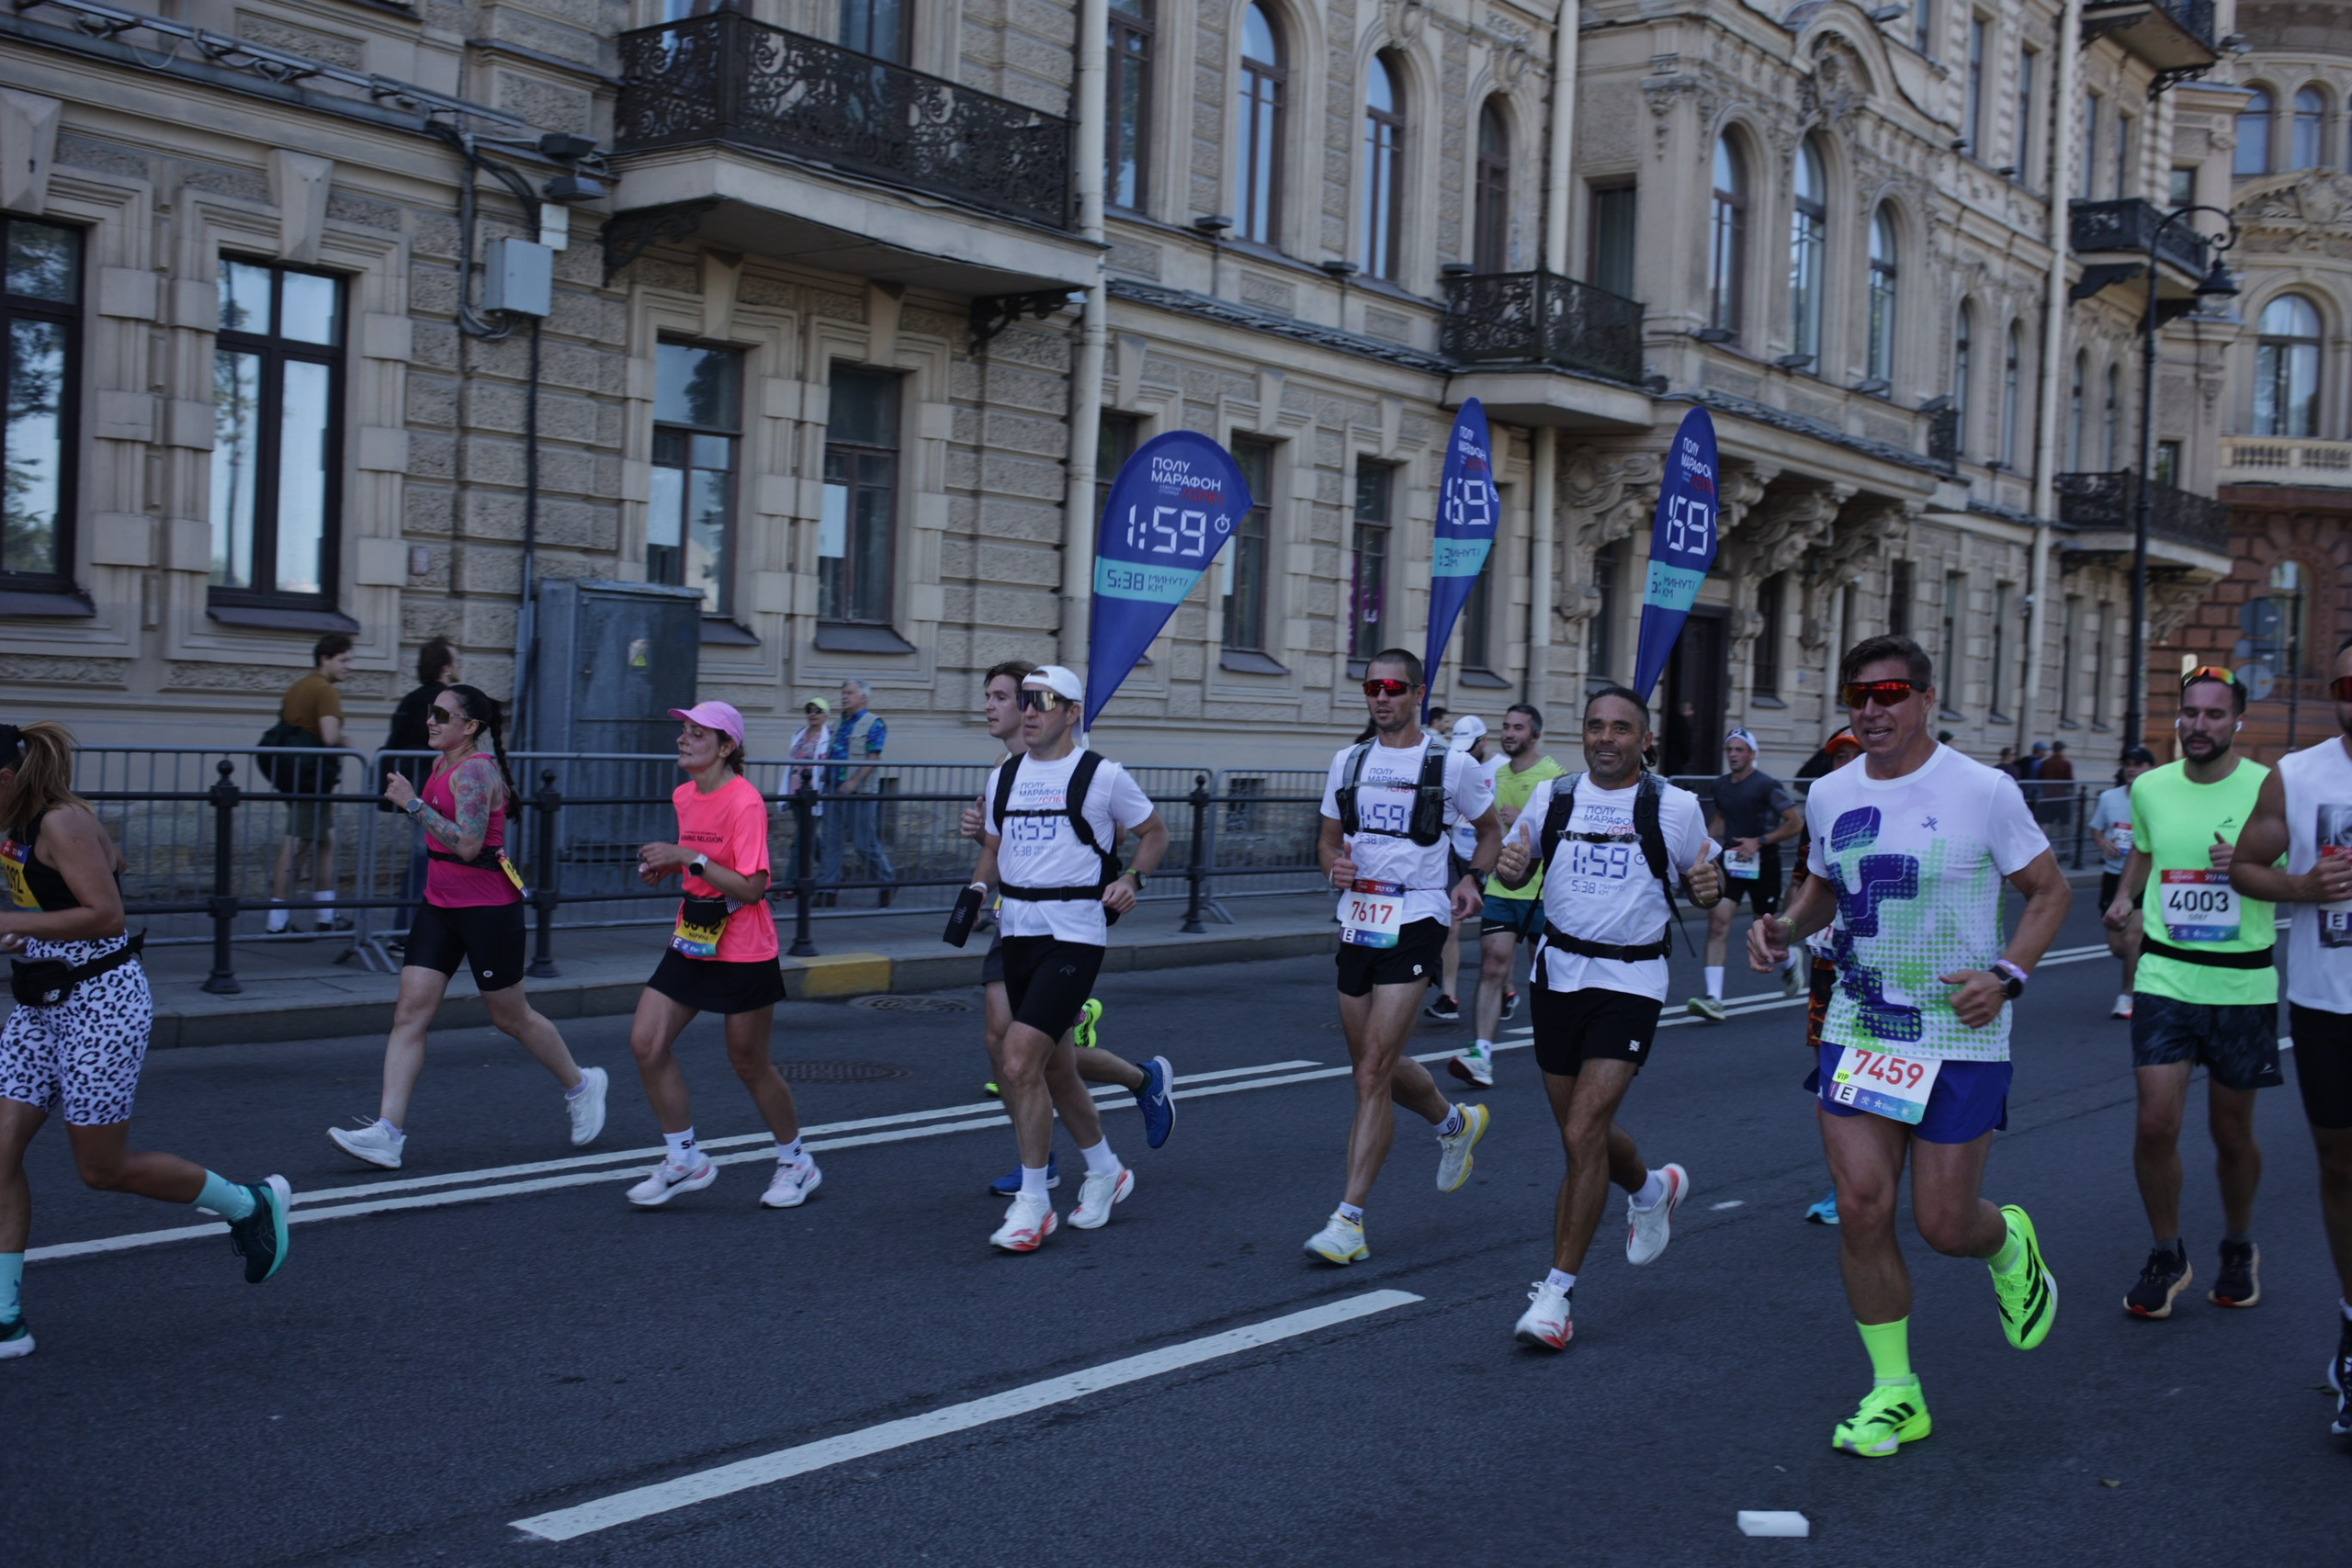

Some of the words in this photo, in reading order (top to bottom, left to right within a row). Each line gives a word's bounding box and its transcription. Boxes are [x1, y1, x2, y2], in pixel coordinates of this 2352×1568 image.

[1152, 457, 1191, 474] ПОЛУ
[1150, 469, 1222, 492] МАРАФОН
[1126, 503, 1206, 558] 1:59
[1107, 569, 1145, 591] 5:38
[1148, 584, 1163, 593] КМ
[1018, 788, 1066, 797] МАРАФОН
[1021, 781, 1046, 789] ПОЛУ
[1361, 803, 1405, 830] 1:59
[1586, 806, 1616, 816] ПОЛУ
[696, 835, 724, 843] RELIGION
[1573, 844, 1630, 880] 1:59
[1571, 879, 1597, 894] 5:38
[2168, 889, 2230, 912] 4003
[1351, 901, 1394, 924] 7617
[2333, 914, 2344, 927] E
[673, 938, 682, 948] E
[1345, 930, 1353, 941] E
[1837, 1071, 1849, 1082] VIP
[1853, 1049, 1925, 1089] 7459
[1839, 1086, 1853, 1101] E
